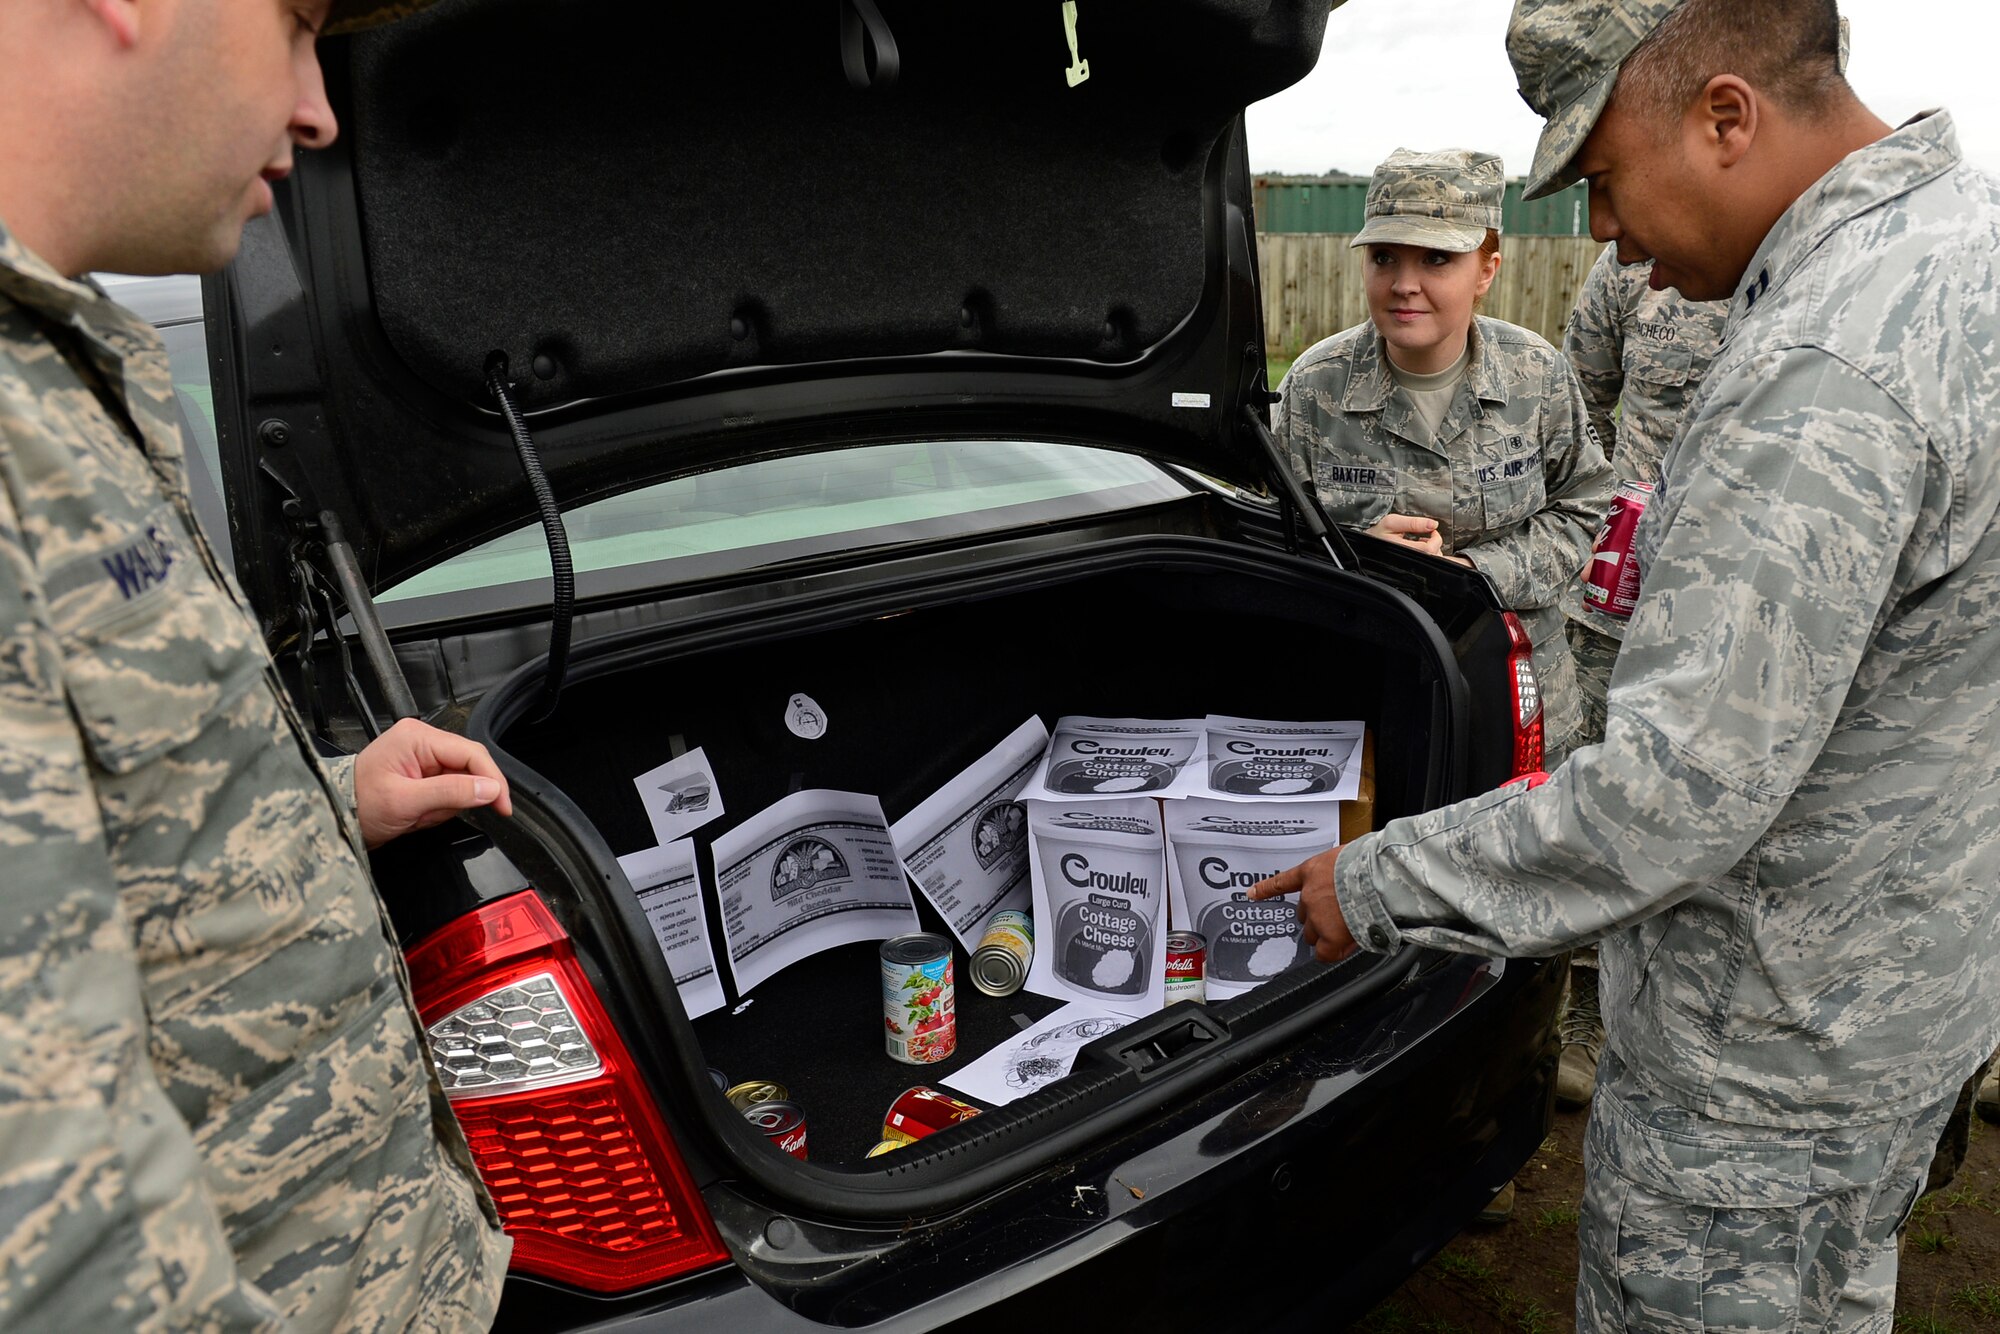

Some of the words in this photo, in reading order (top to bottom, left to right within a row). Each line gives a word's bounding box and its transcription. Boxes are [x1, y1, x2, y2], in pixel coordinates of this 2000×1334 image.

[1332, 466, 1376, 485] BAXTER
[1479, 466, 1499, 483] U.S.
[1502, 461, 1524, 478] AIR
[1071, 739, 1171, 757] Crowley
[1226, 740, 1329, 757] Crowley
[1081, 761, 1153, 771] Cottage
[1085, 768, 1150, 777] Cheese
[1241, 762, 1314, 771] Cottage
[1247, 770, 1313, 779] Cheese
[1060, 853, 1148, 899] Crowley
[787, 897, 803, 909] Mild
[805, 885, 842, 900] Cheddar
[800, 898, 831, 912] Cheese
[1091, 895, 1111, 907] Large
[1112, 900, 1128, 909] Curd
[660, 911, 675, 921] PEPPER
[675, 908, 687, 917] JACK
[1079, 906, 1137, 934] Cottage
[1222, 905, 1296, 922] Cottage
[662, 922, 676, 932] SHARP
[676, 916, 697, 927] CHEDDAR
[1230, 921, 1296, 936] Cheese
[664, 933, 678, 942] COLBY
[678, 929, 689, 937] JACK
[666, 939, 689, 951] MONTEREY
[689, 935, 700, 944] JACK
[1083, 925, 1136, 948] Cheese
[1166, 983, 1196, 992] Mushroom
